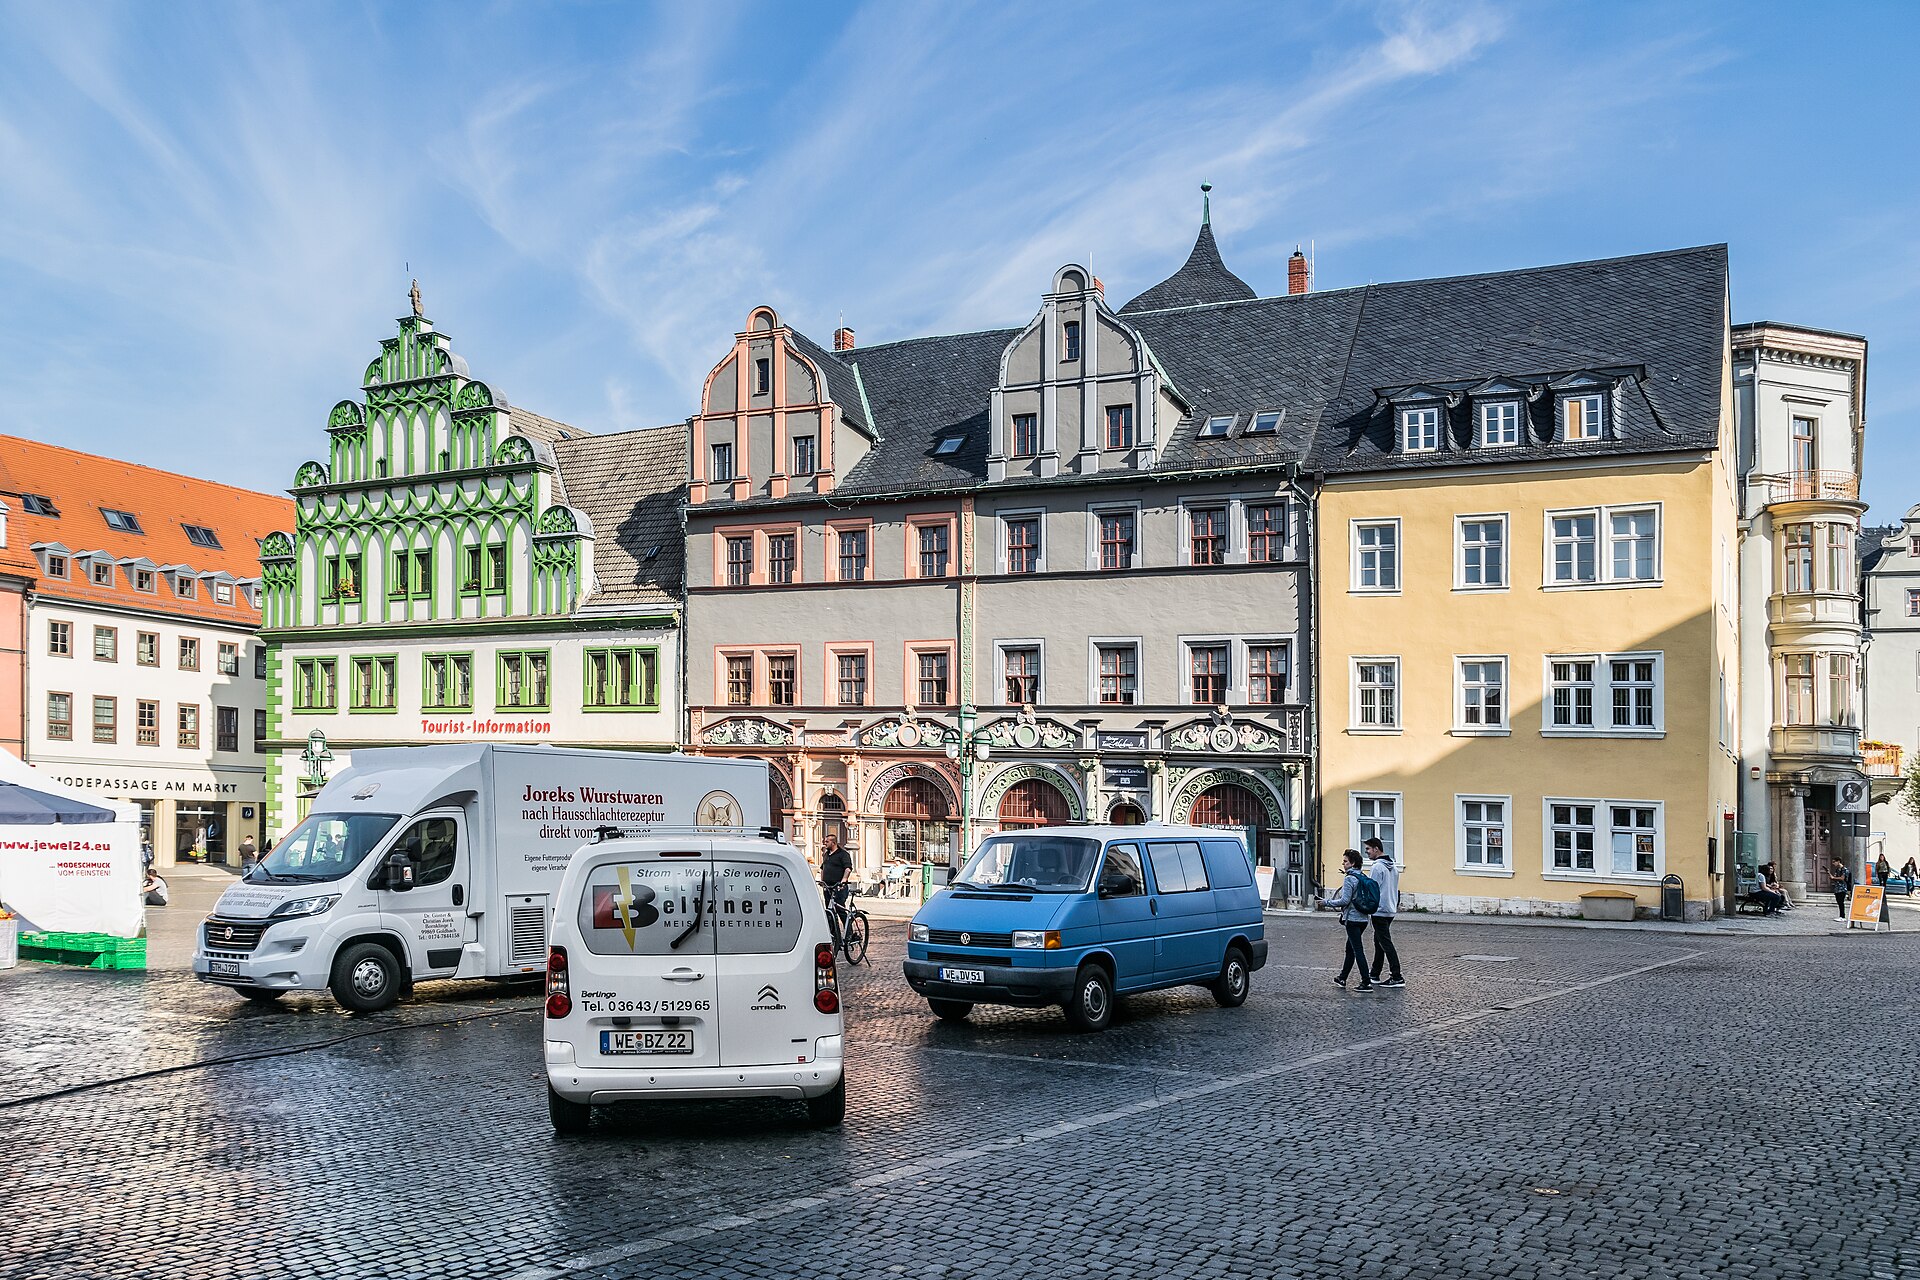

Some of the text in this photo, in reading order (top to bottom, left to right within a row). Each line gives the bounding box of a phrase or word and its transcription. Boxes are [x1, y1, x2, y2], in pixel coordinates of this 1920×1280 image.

[421, 719, 551, 733] Tourist-Information
[165, 782, 185, 791] AM
[193, 783, 238, 793] MARKT
[523, 785, 664, 805] Joreks Wurstwaren
[522, 806, 665, 824] nach Hausschlachterezeptur
[540, 824, 571, 838] direkt
[0, 840, 111, 852] ww.jewel24.eu
[525, 854, 572, 862] Eigene Futterprodu
[532, 863, 568, 872] eigene Verarbe
[637, 869, 671, 877] Strom
[723, 869, 740, 877] Sie
[744, 869, 781, 878] wollen
[664, 920, 771, 928] MEISEBETRIEB
[945, 969, 956, 979] WE
[581, 990, 617, 999] Berlingo
[581, 1001, 604, 1012] Tel.
[615, 1033, 635, 1049] WE
[644, 1033, 665, 1049] BZ
[667, 1033, 686, 1049] 22
